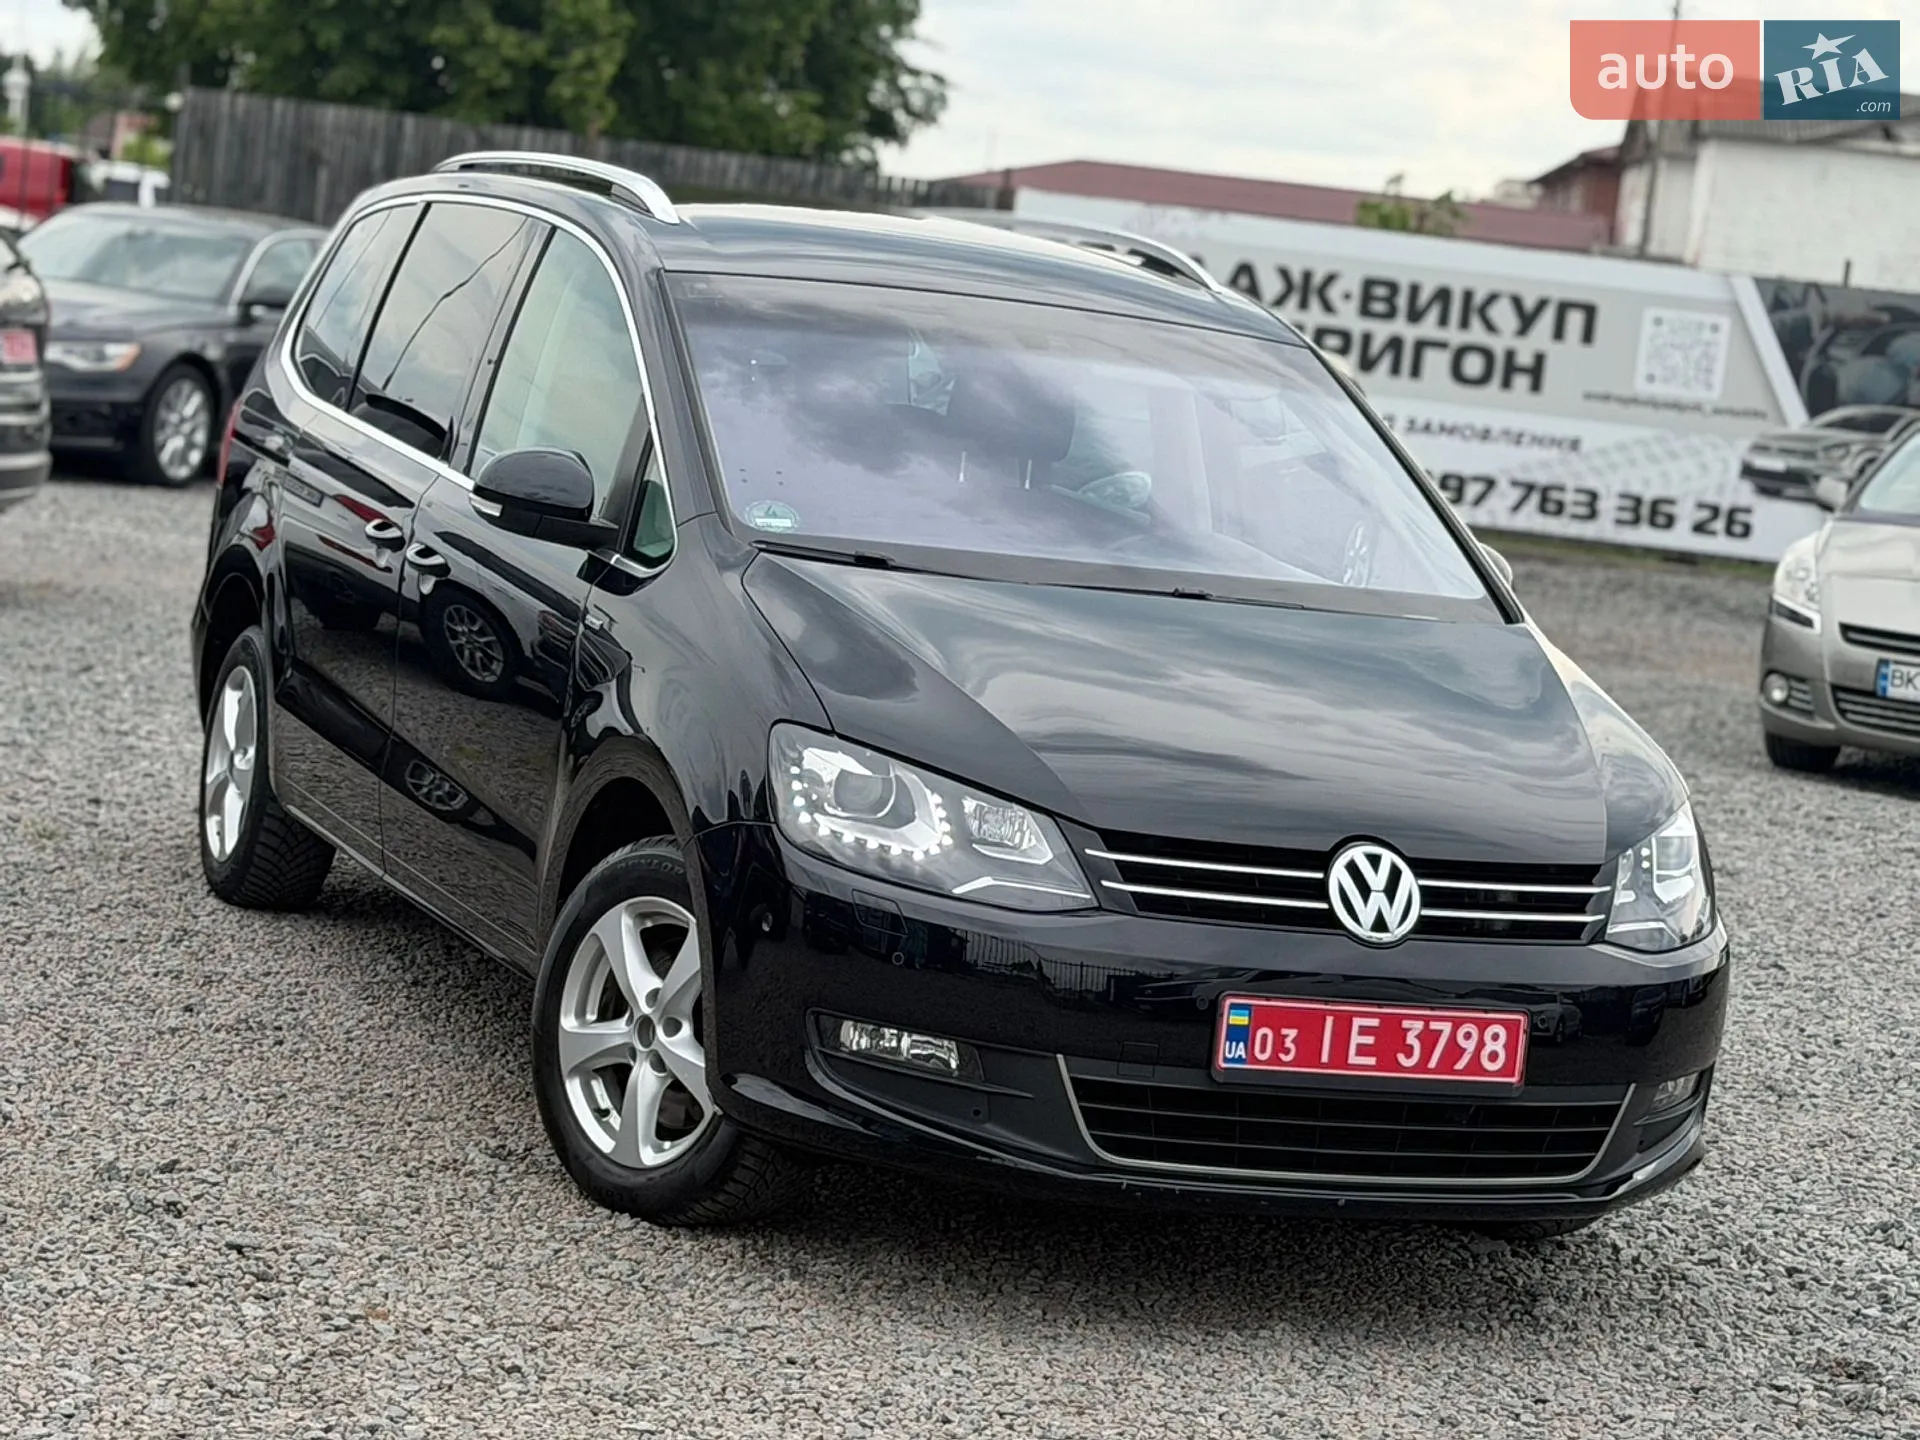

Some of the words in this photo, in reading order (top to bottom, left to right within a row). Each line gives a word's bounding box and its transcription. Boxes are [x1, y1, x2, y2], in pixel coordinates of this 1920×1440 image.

[1294, 322, 1547, 392] РИГОН
[1404, 415, 1583, 452] ЗАМОВЛЕННЯ
[1425, 470, 1496, 508] 97
[1509, 480, 1599, 521] 763
[1614, 492, 1677, 531] 36
[1691, 501, 1754, 539] 26
[1225, 1040, 1247, 1061] UA
[1253, 1026, 1299, 1063] 03
[1319, 1015, 1381, 1066] IE
[1396, 1020, 1508, 1072] 3798
